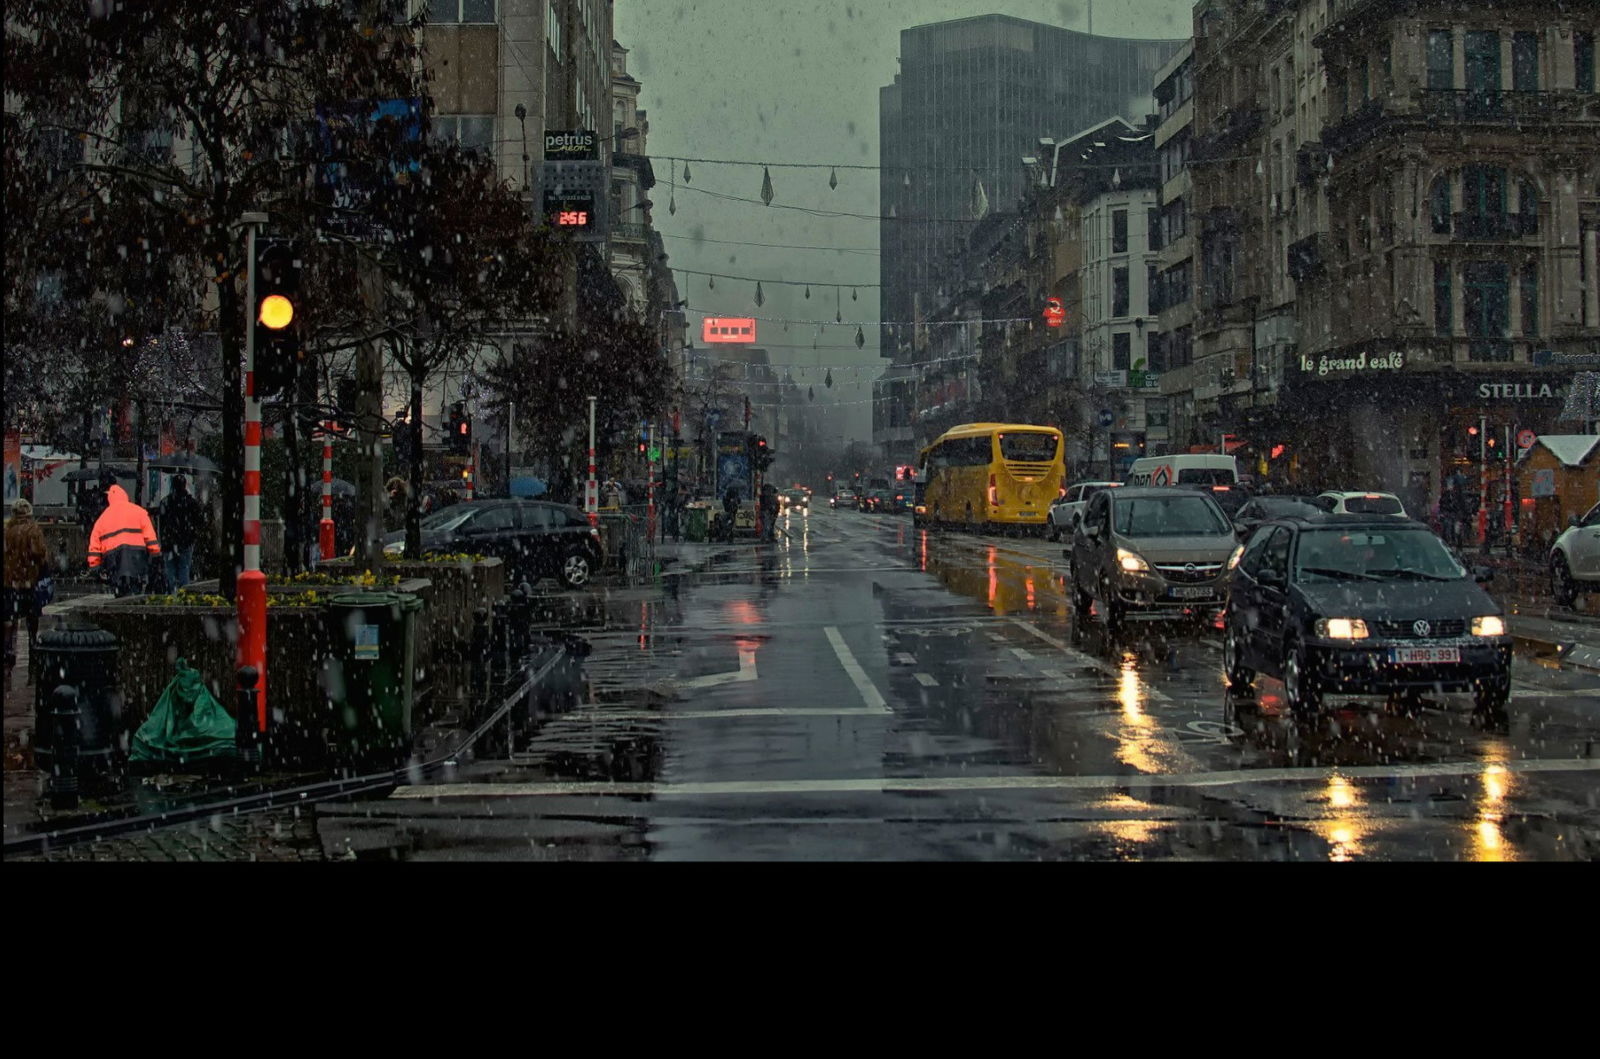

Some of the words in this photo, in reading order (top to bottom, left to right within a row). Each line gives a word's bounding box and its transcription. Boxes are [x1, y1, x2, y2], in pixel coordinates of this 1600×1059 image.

[545, 133, 592, 151] petrus
[1300, 354, 1314, 371] le
[1319, 351, 1366, 376] grand
[1370, 351, 1404, 369] café
[1479, 383, 1553, 399] STELLA
